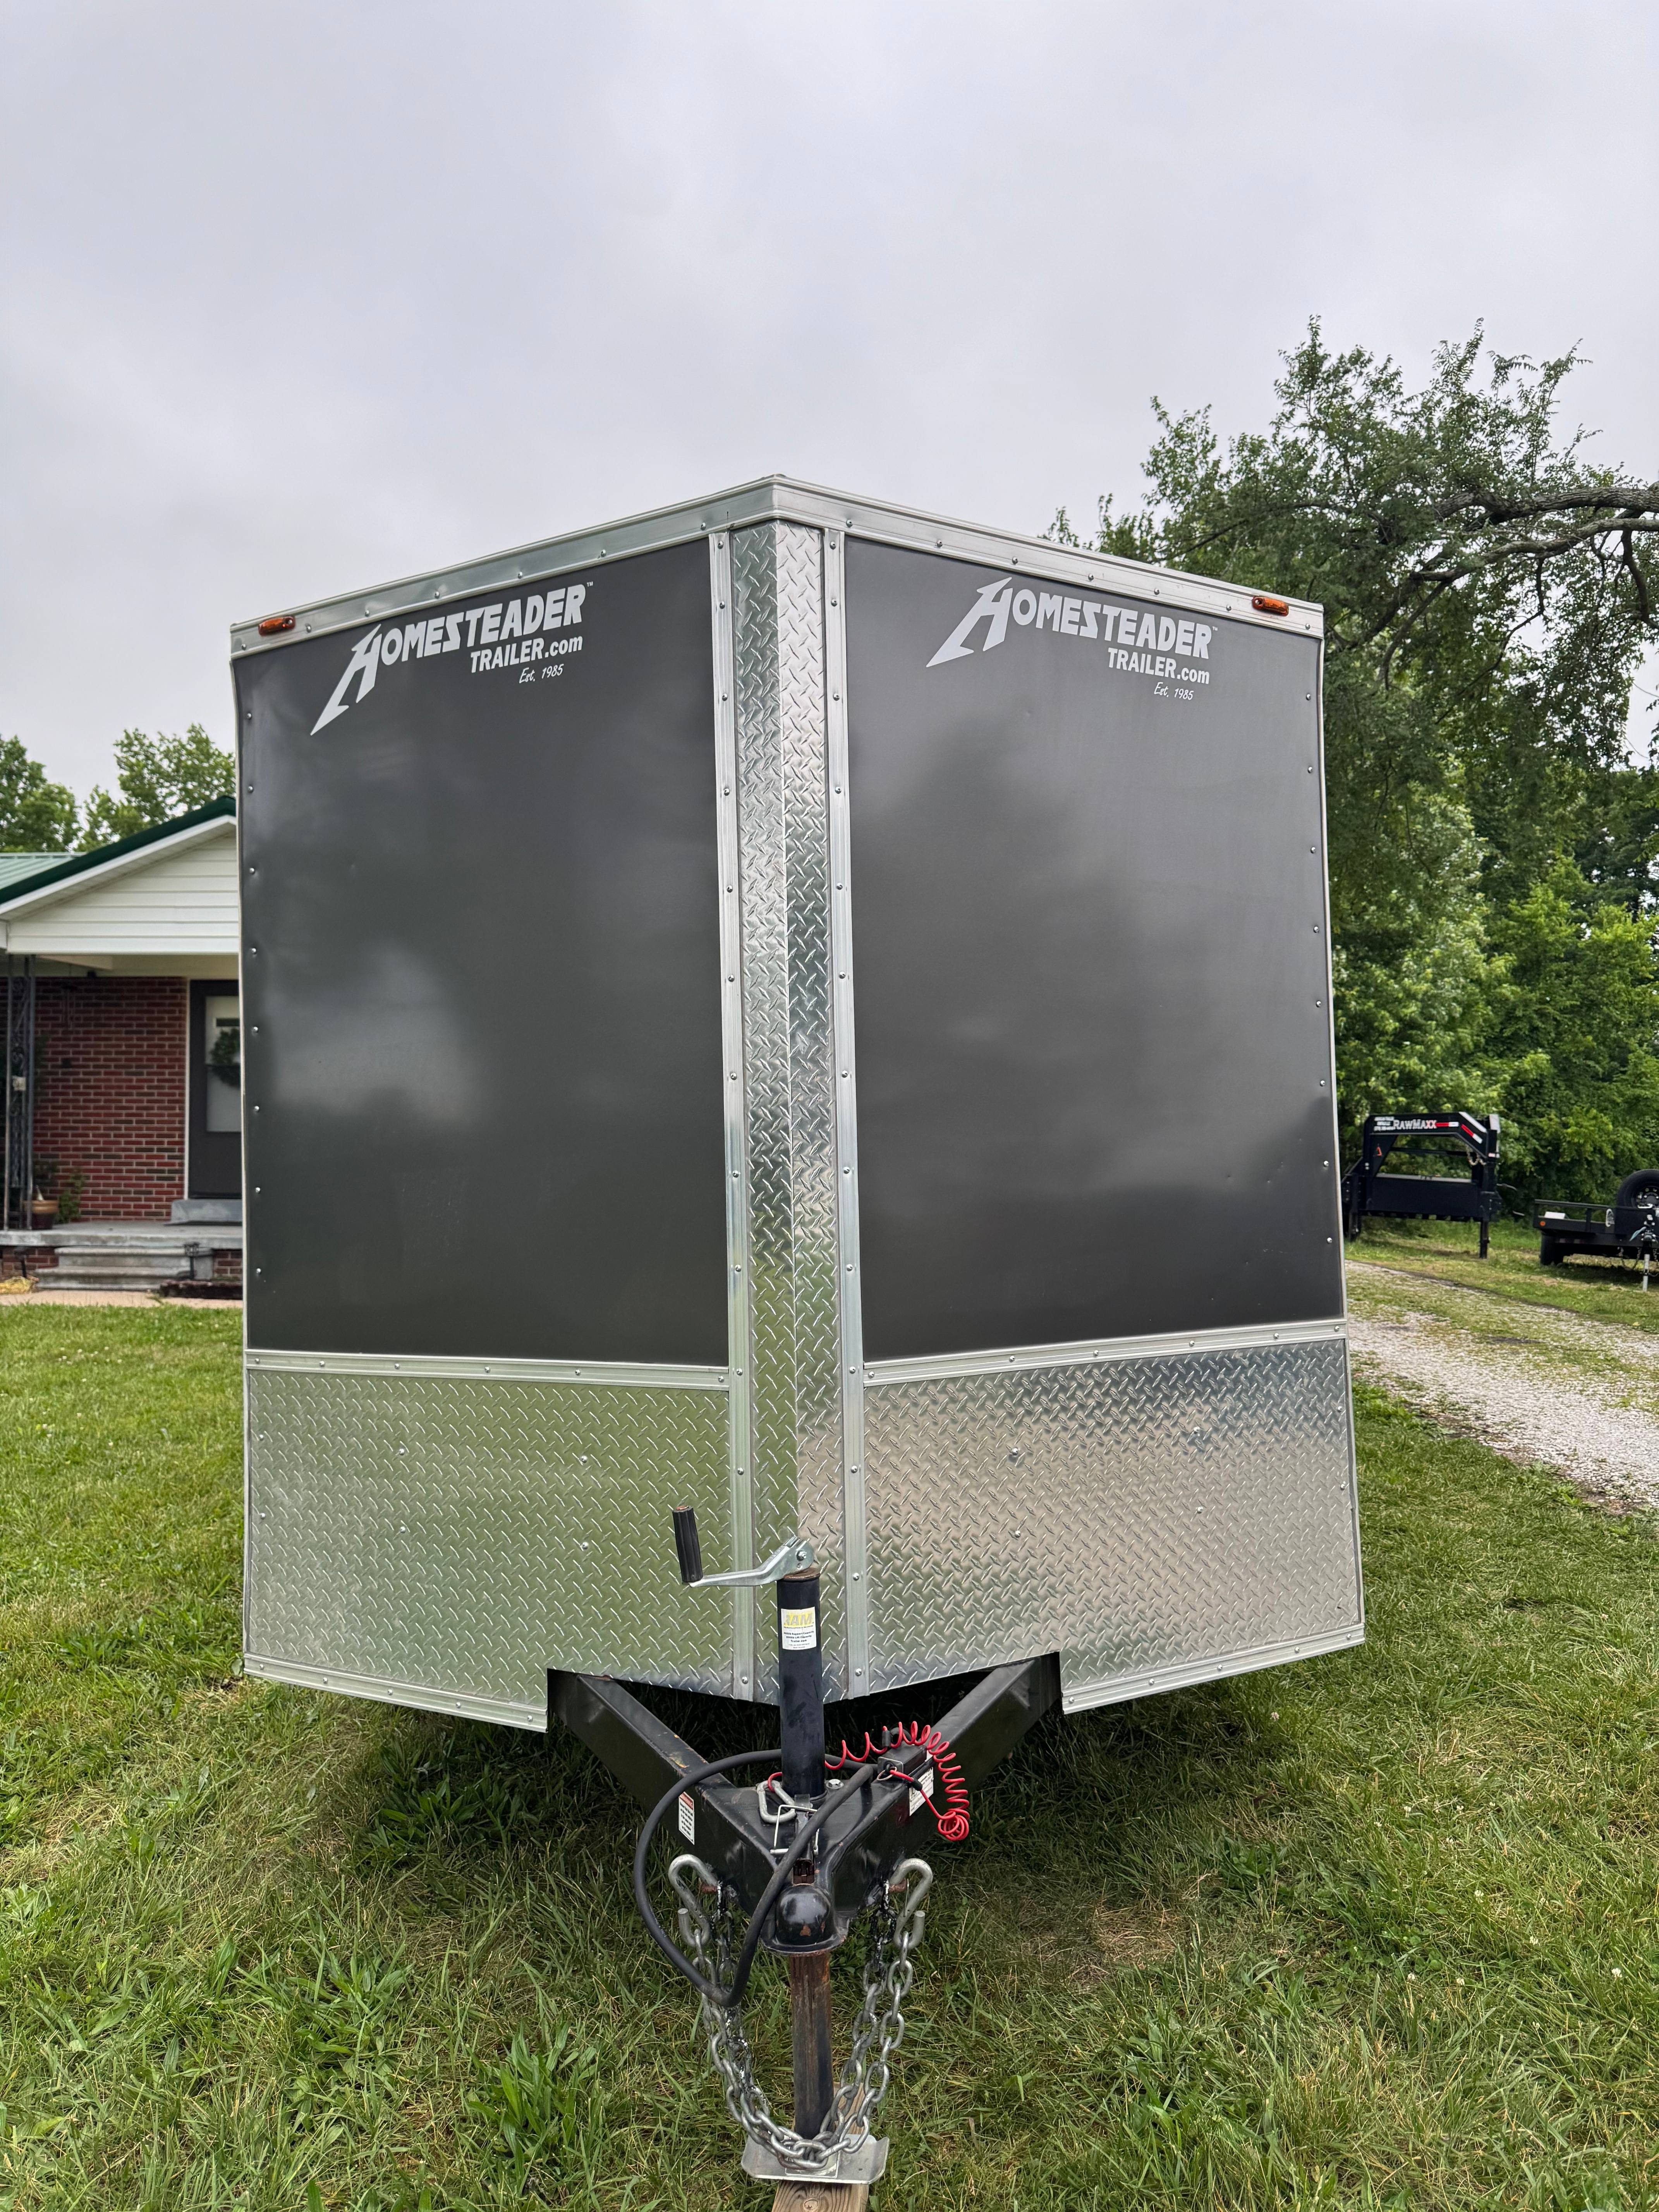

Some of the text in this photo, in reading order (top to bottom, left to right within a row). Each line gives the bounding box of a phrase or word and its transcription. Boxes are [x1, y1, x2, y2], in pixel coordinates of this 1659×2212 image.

[926, 577, 1212, 667] HOMESTEADER
[310, 584, 586, 736] HOMESTEADER
[471, 636, 583, 673] TRAILER.com
[1108, 647, 1210, 684] TRAILER.com
[519, 663, 564, 684] Est. 1985
[1154, 682, 1194, 701] Est. 1985
